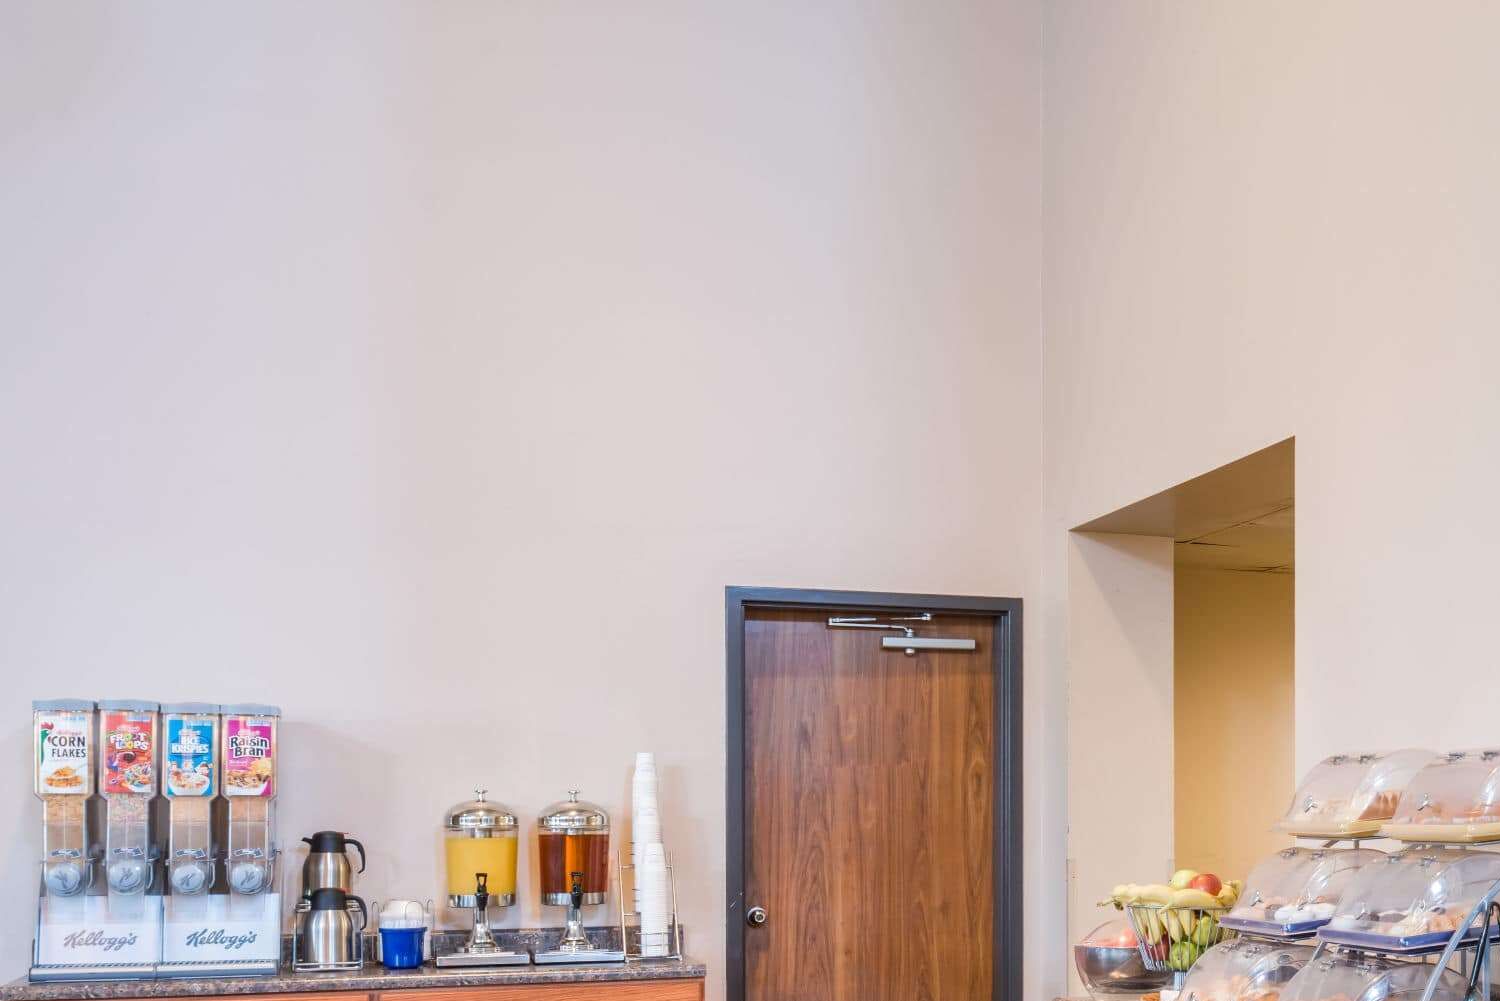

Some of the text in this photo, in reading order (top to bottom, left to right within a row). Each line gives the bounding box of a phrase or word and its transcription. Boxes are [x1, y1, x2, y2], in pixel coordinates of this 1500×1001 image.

[51, 735, 86, 748] CORN
[229, 736, 268, 748] Raisin
[51, 748, 86, 759] FLAKES
[234, 746, 264, 758] Bran
[63, 929, 138, 952] Kellogg's
[185, 928, 258, 950] Kellogg's
